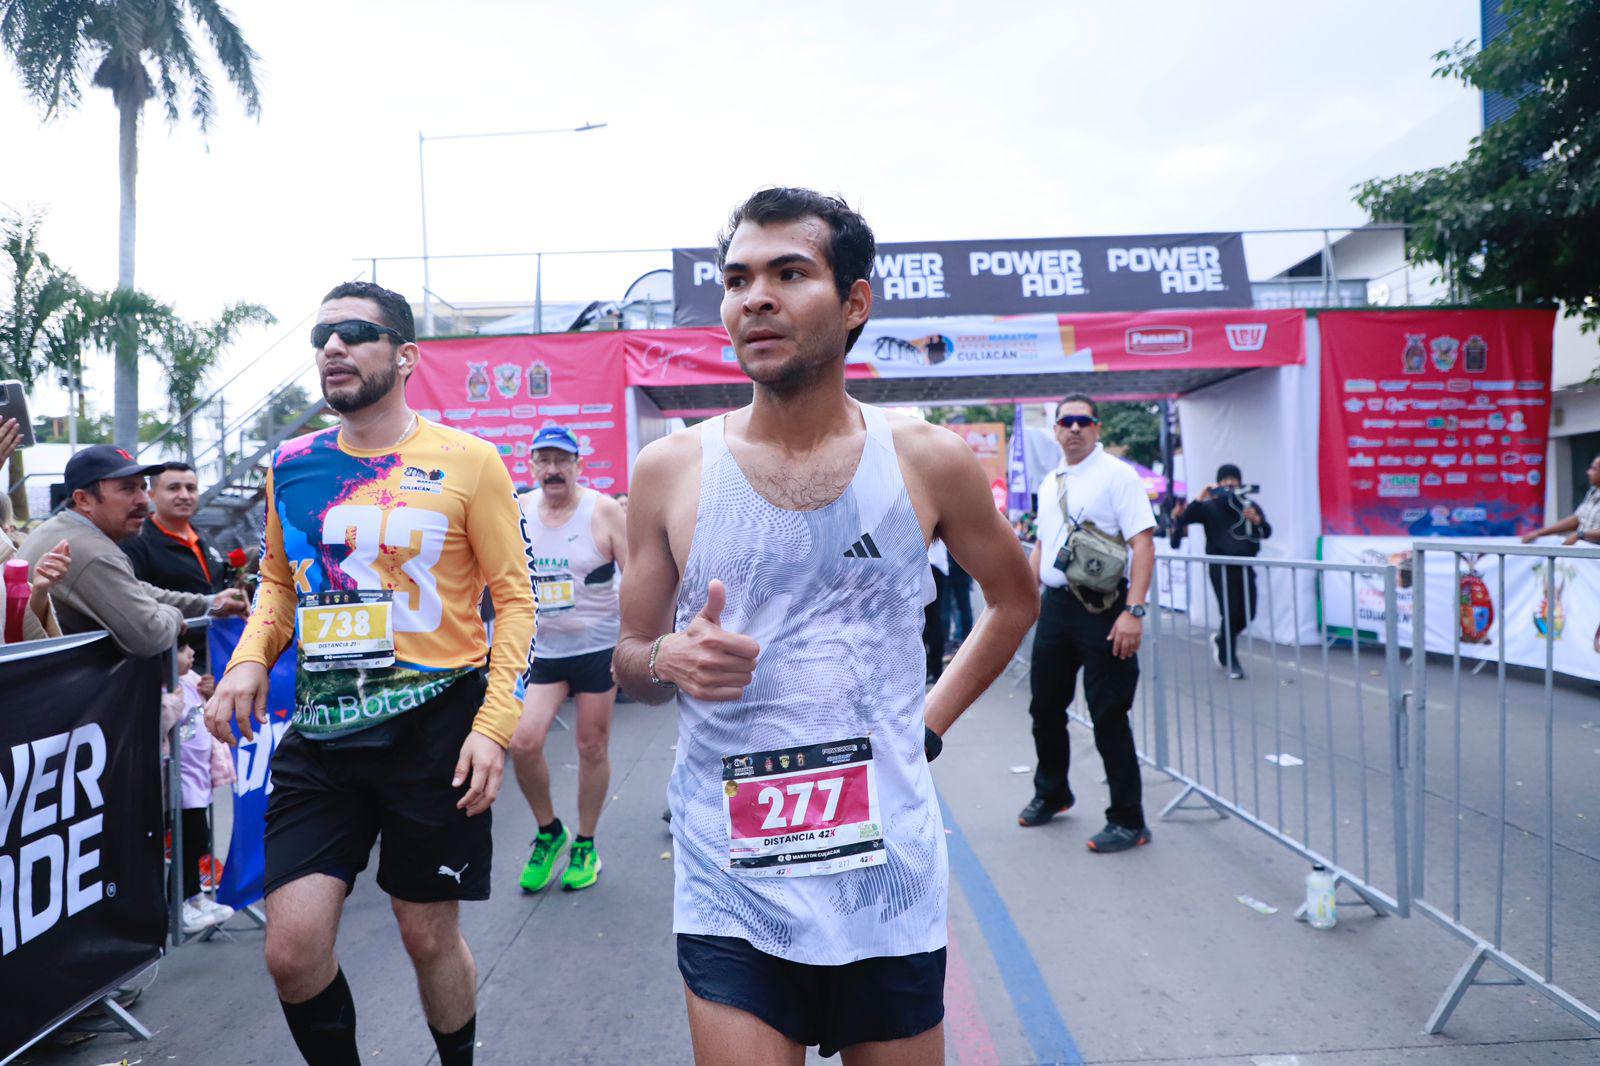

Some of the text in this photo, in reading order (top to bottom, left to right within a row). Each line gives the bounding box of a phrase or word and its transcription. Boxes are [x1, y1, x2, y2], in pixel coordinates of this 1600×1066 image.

[870, 253, 944, 279] WER
[969, 249, 1082, 276] POWER
[1107, 245, 1220, 272] POWER
[883, 275, 945, 300] ADE
[1021, 272, 1085, 298] ADE
[1160, 268, 1224, 294] ADE
[322, 505, 449, 633] 33
[318, 609, 371, 640] 738
[758, 776, 844, 830] 277
[763, 832, 815, 847] DISTANCIA
